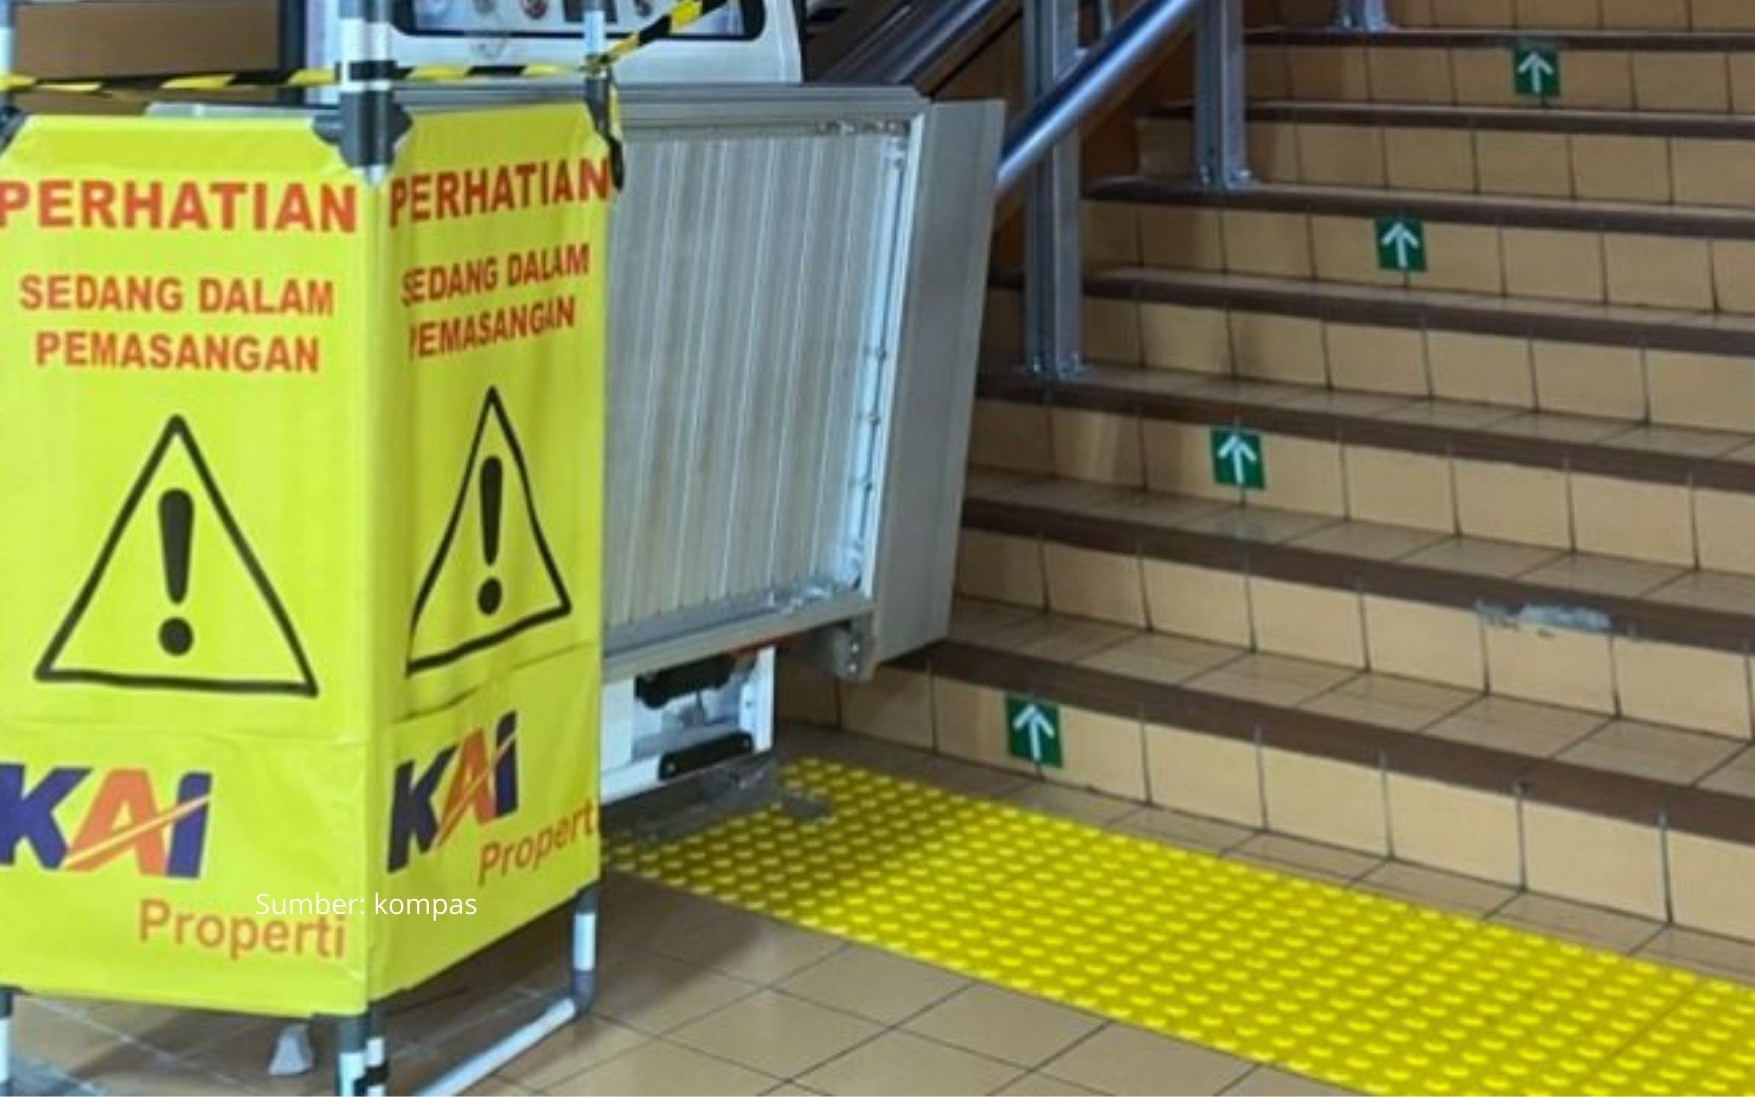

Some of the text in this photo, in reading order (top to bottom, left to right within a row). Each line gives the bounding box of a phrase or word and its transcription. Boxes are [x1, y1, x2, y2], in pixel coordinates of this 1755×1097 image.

[0, 179, 357, 233] PERHATIAN
[388, 157, 611, 228] PERHATIAN
[20, 274, 334, 317] SEDANG DALAM
[401, 242, 590, 307] SEDANG DALAM
[36, 330, 320, 373] PEMASANGAN
[0, 763, 212, 878] KAI
[387, 711, 518, 873] KAI
[138, 899, 346, 959] Properti
